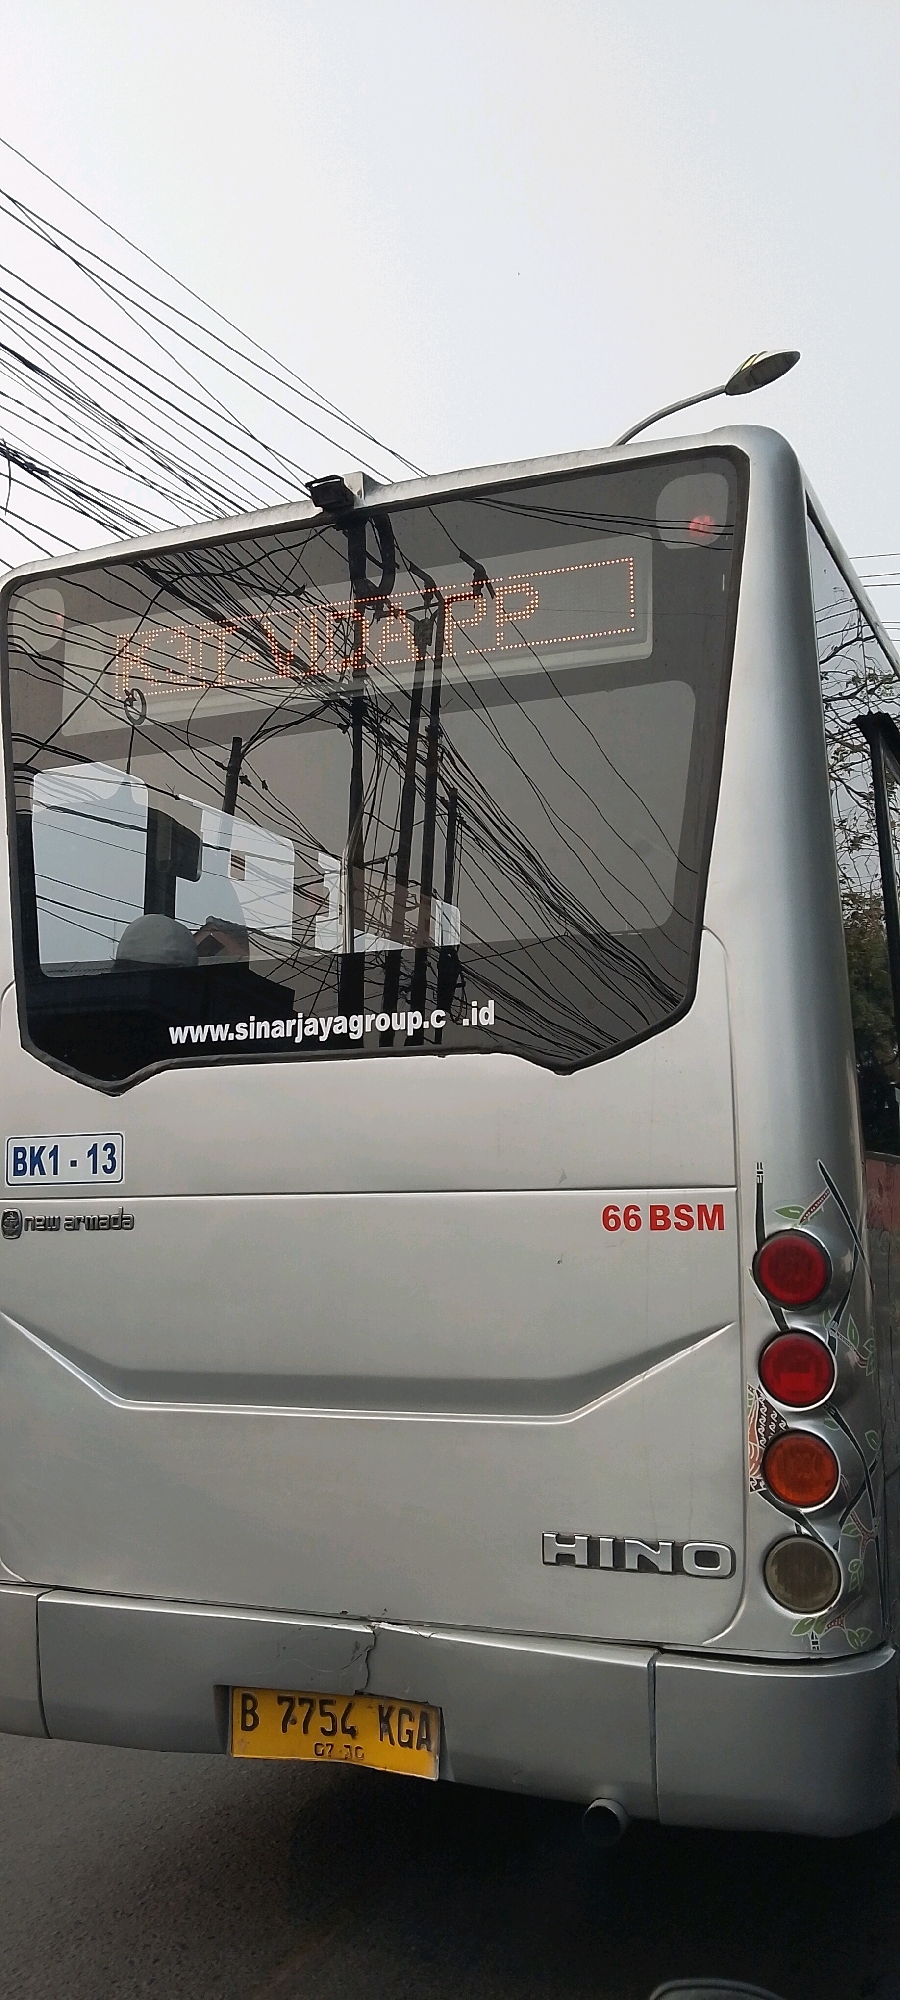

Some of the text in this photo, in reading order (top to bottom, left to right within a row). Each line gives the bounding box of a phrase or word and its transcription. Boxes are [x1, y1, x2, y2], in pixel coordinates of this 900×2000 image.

[168, 1000, 496, 1045] www.sinarjayagroup.c.id
[12, 1144, 60, 1177] BK1
[86, 1142, 117, 1175] 13
[24, 1206, 135, 1232] new armada
[602, 1203, 725, 1232] 66 BSM
[541, 1531, 737, 1579] HINO
[240, 1692, 432, 1752] B 7754 KGA
